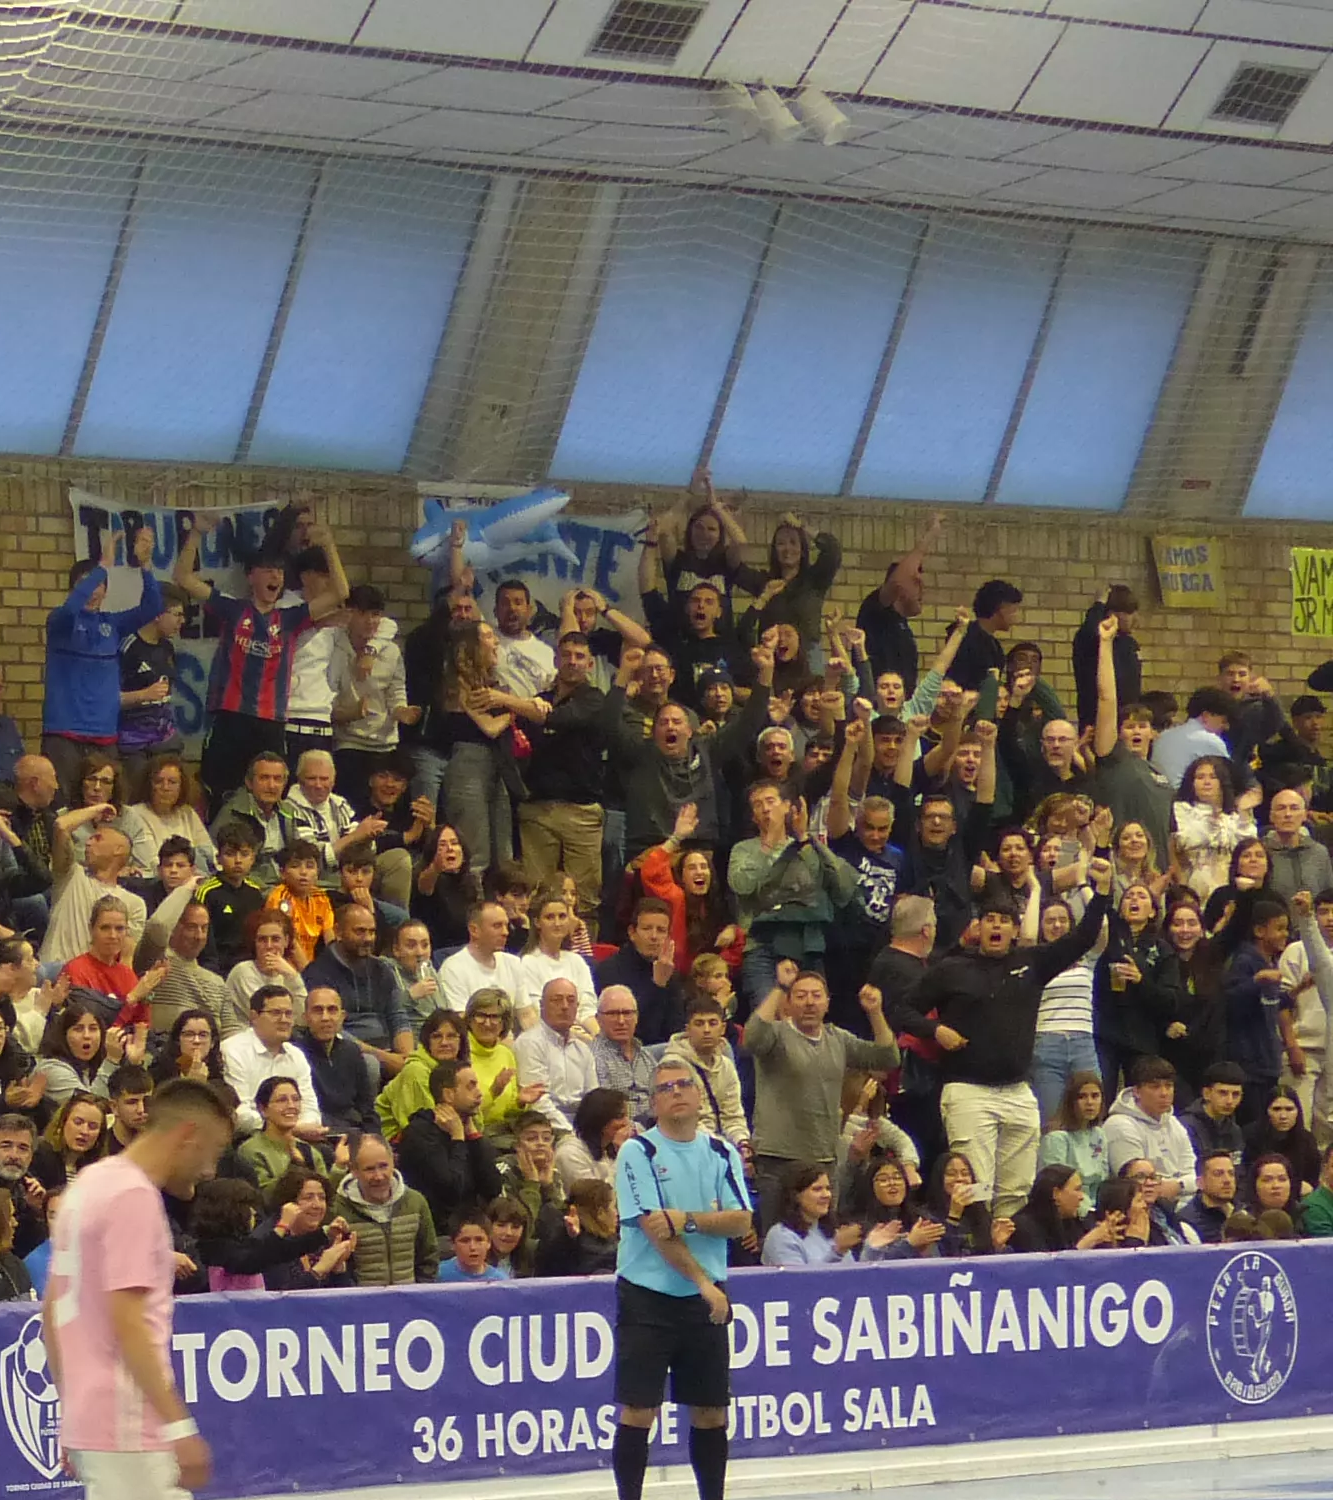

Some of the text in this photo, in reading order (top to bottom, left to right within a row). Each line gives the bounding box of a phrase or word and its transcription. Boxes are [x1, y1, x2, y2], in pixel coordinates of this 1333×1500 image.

[1165, 545, 1210, 567] AMOS
[1293, 555, 1333, 597] VAM
[172, 1271, 1175, 1403] TORNEO CIUD DE SABIÑANIGO
[412, 1384, 937, 1463] 36 HORAS E TBOL SALA
